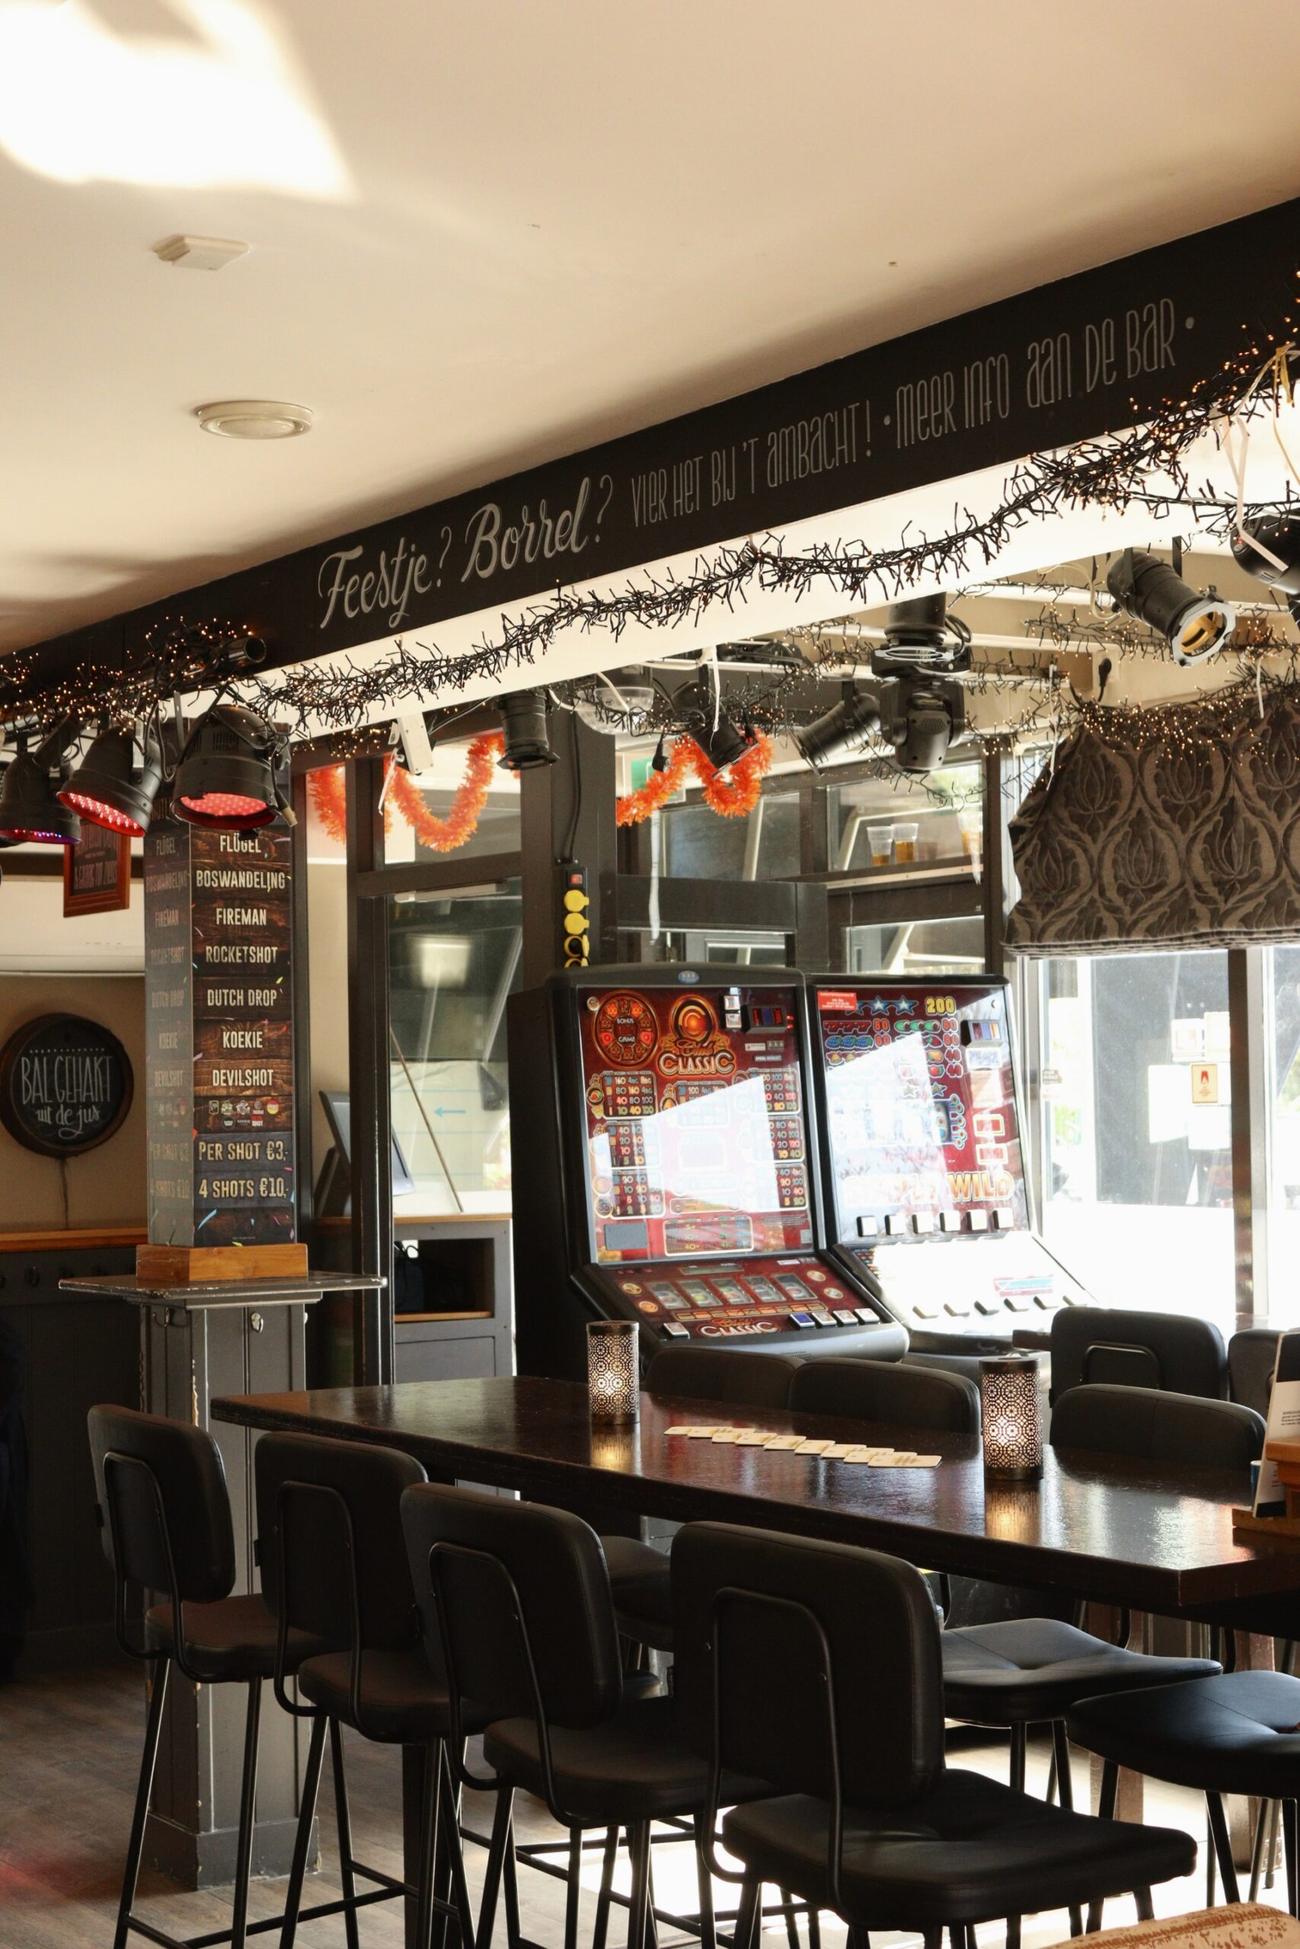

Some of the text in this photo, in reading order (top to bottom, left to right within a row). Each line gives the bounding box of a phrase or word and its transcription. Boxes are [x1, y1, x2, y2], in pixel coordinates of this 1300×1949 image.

[317, 526, 453, 629] Feestje?
[460, 474, 614, 583] Borrel?
[711, 446, 736, 507] BIJ
[196, 870, 286, 889] BOSWANDELING
[216, 907, 268, 926] FIREMAN
[205, 946, 279, 963] ROCKETSHOT
[207, 988, 278, 1007] DUTCH DROP
[926, 997, 956, 1015] 200
[223, 1031, 264, 1049] KOEKIE
[659, 1051, 736, 1076] CLASSIC
[212, 1068, 275, 1087] DEVILSHOT
[55, 1104, 73, 1126] de
[58, 1105, 101, 1140] jus
[199, 1141, 224, 1161] PER
[227, 1142, 262, 1160] SHOT
[198, 1179, 209, 1198] 4
[212, 1180, 255, 1198] SHOTS
